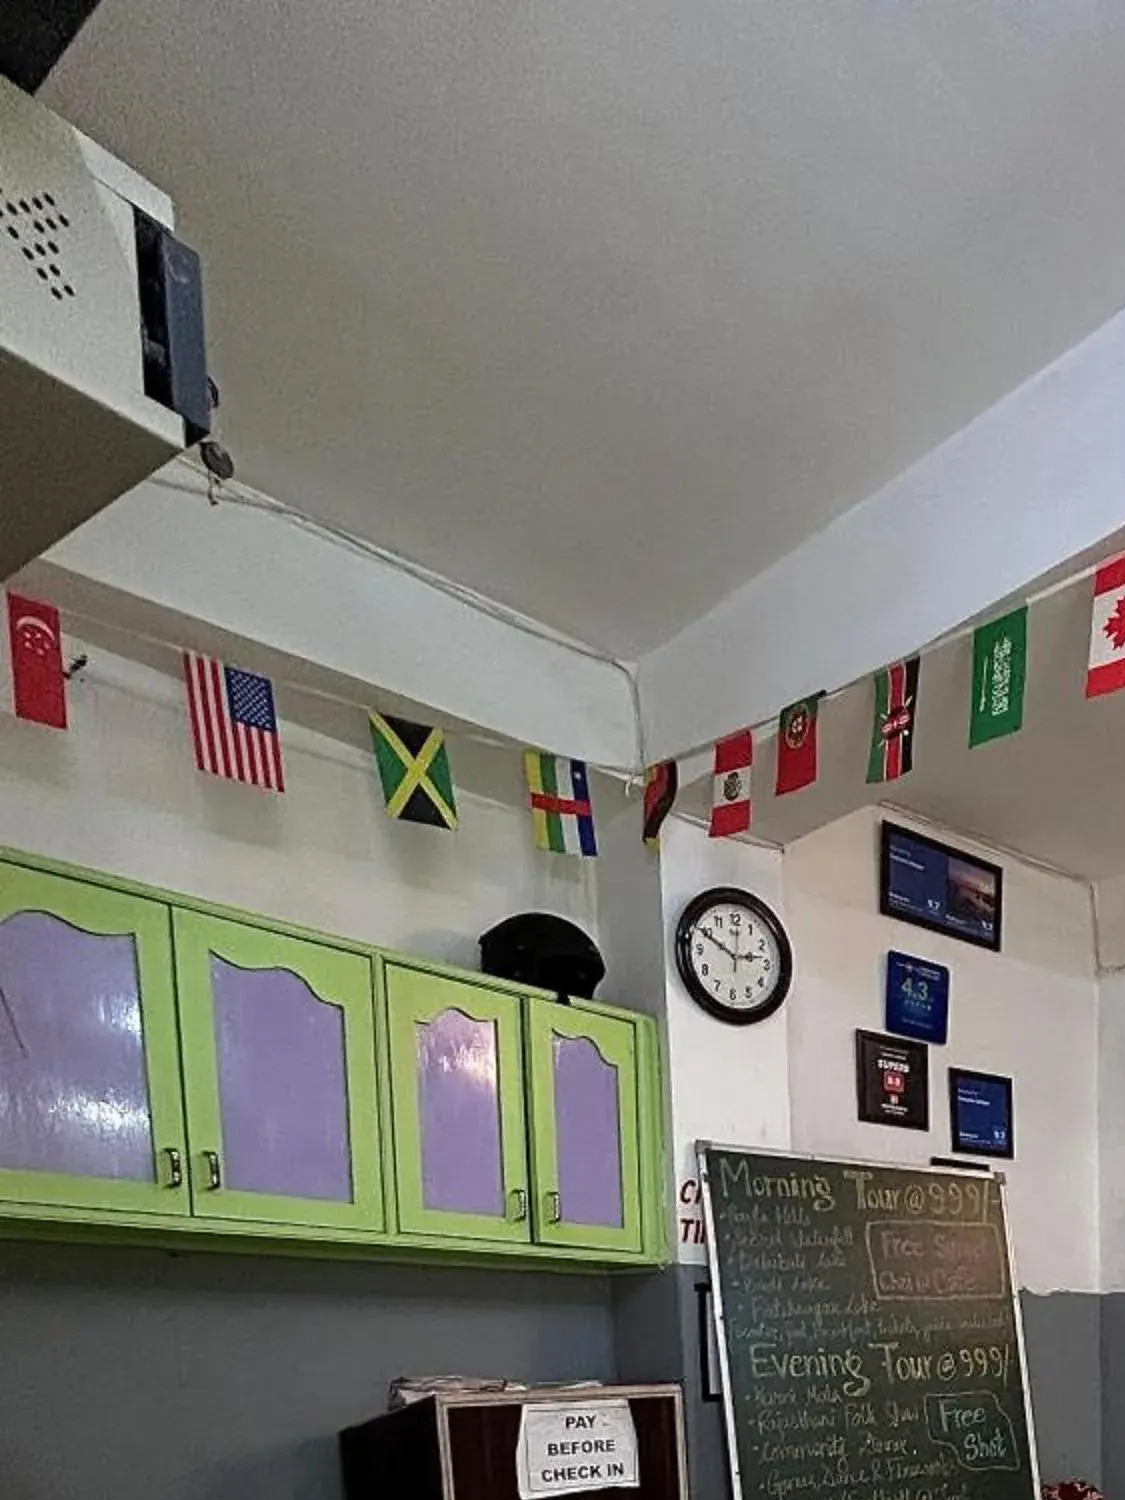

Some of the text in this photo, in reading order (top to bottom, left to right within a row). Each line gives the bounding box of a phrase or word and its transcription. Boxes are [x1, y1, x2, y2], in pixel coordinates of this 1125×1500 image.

[718, 1157, 837, 1212] Morning
[843, 1169, 899, 1211] Tour
[751, 1342, 871, 1397] Evening
[867, 1342, 933, 1385] Tour
[565, 1415, 597, 1430] PAY
[940, 1399, 985, 1432] Free
[547, 1439, 616, 1456] BEFORE
[541, 1463, 625, 1482] CHECK IN
